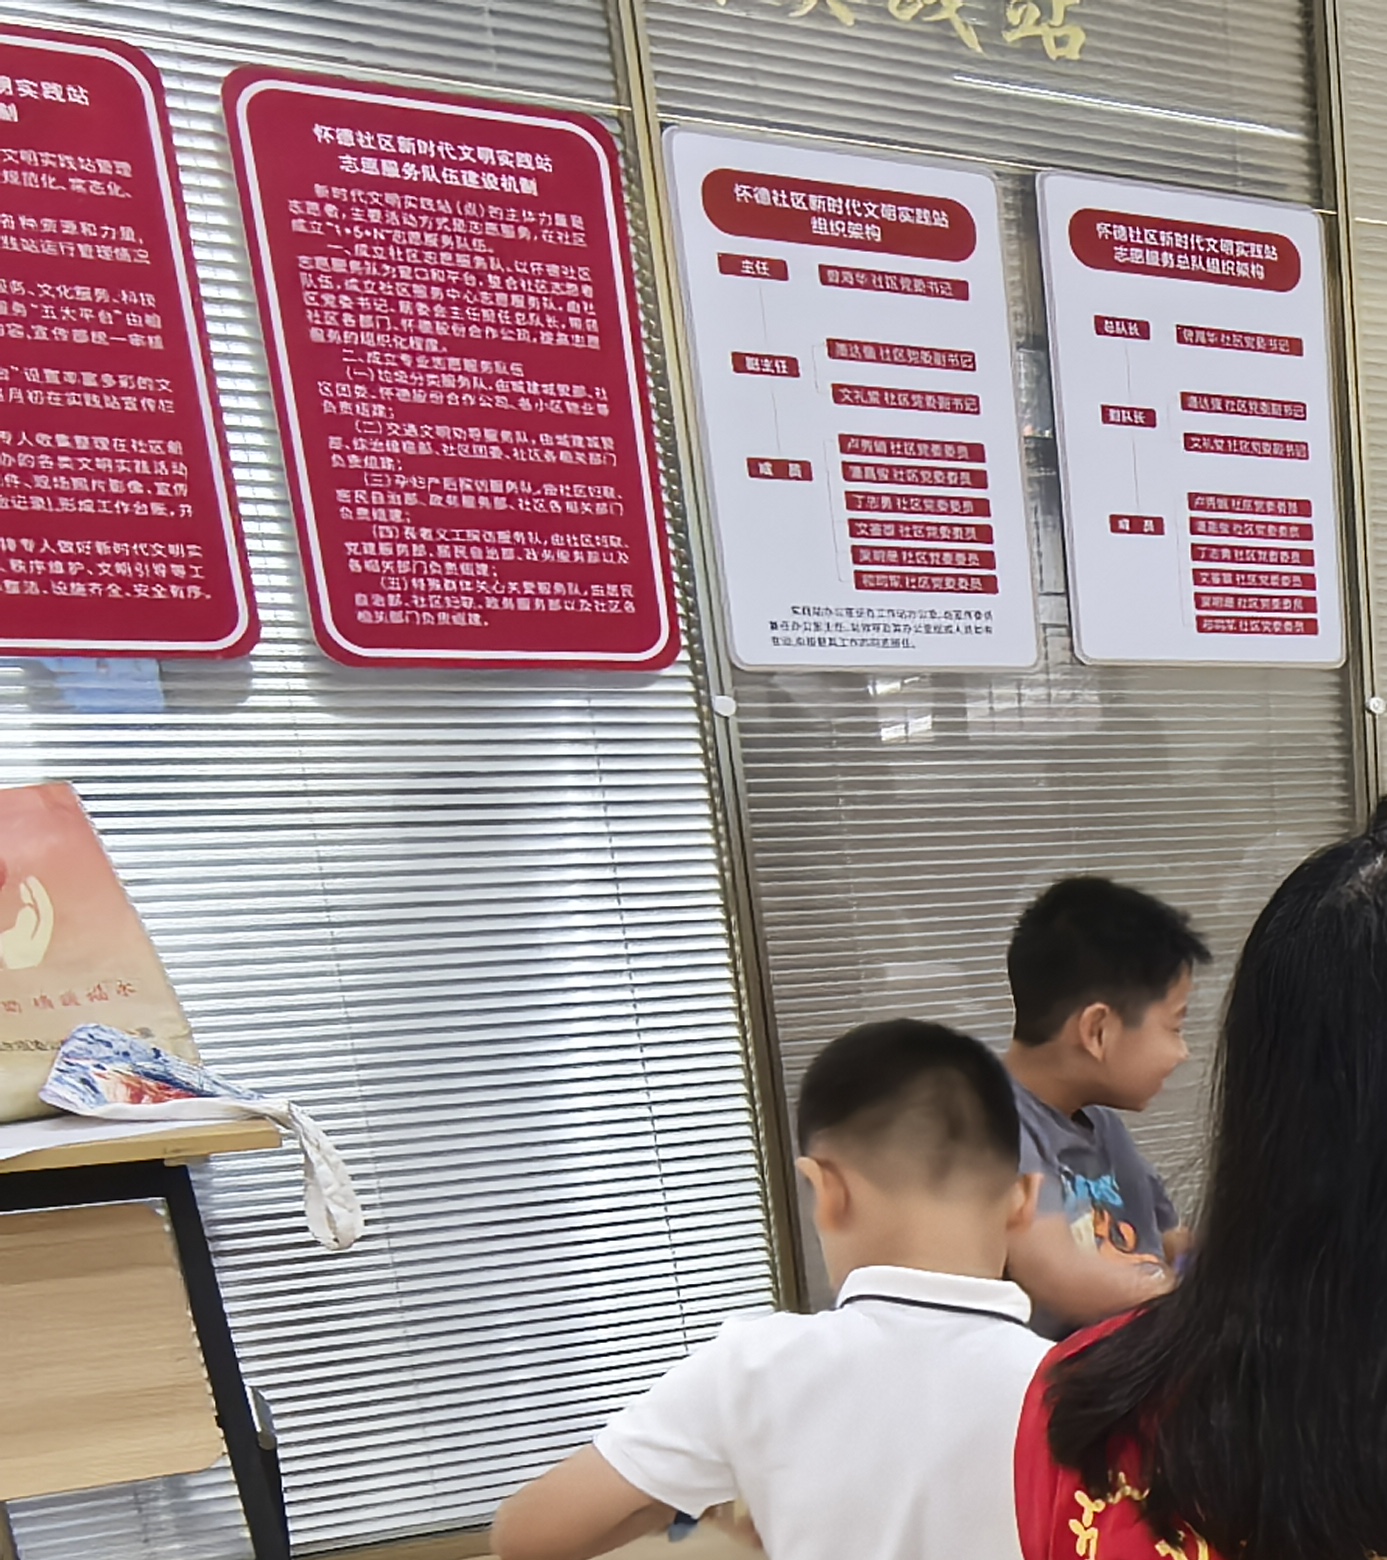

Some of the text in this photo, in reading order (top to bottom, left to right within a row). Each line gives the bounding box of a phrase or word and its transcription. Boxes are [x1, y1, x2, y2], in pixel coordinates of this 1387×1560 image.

[313, 124, 553, 172] 怀德社区新时代文明实践站
[338, 154, 539, 196] 志愿服务队伍建设机制
[733, 183, 950, 229] 怀德社区新时代文明实践站
[811, 216, 882, 243] 组织架构
[1097, 222, 1279, 261] 怀德社区新时代文明实践站
[740, 259, 770, 277] 主任
[1104, 319, 1141, 337] 总队长
